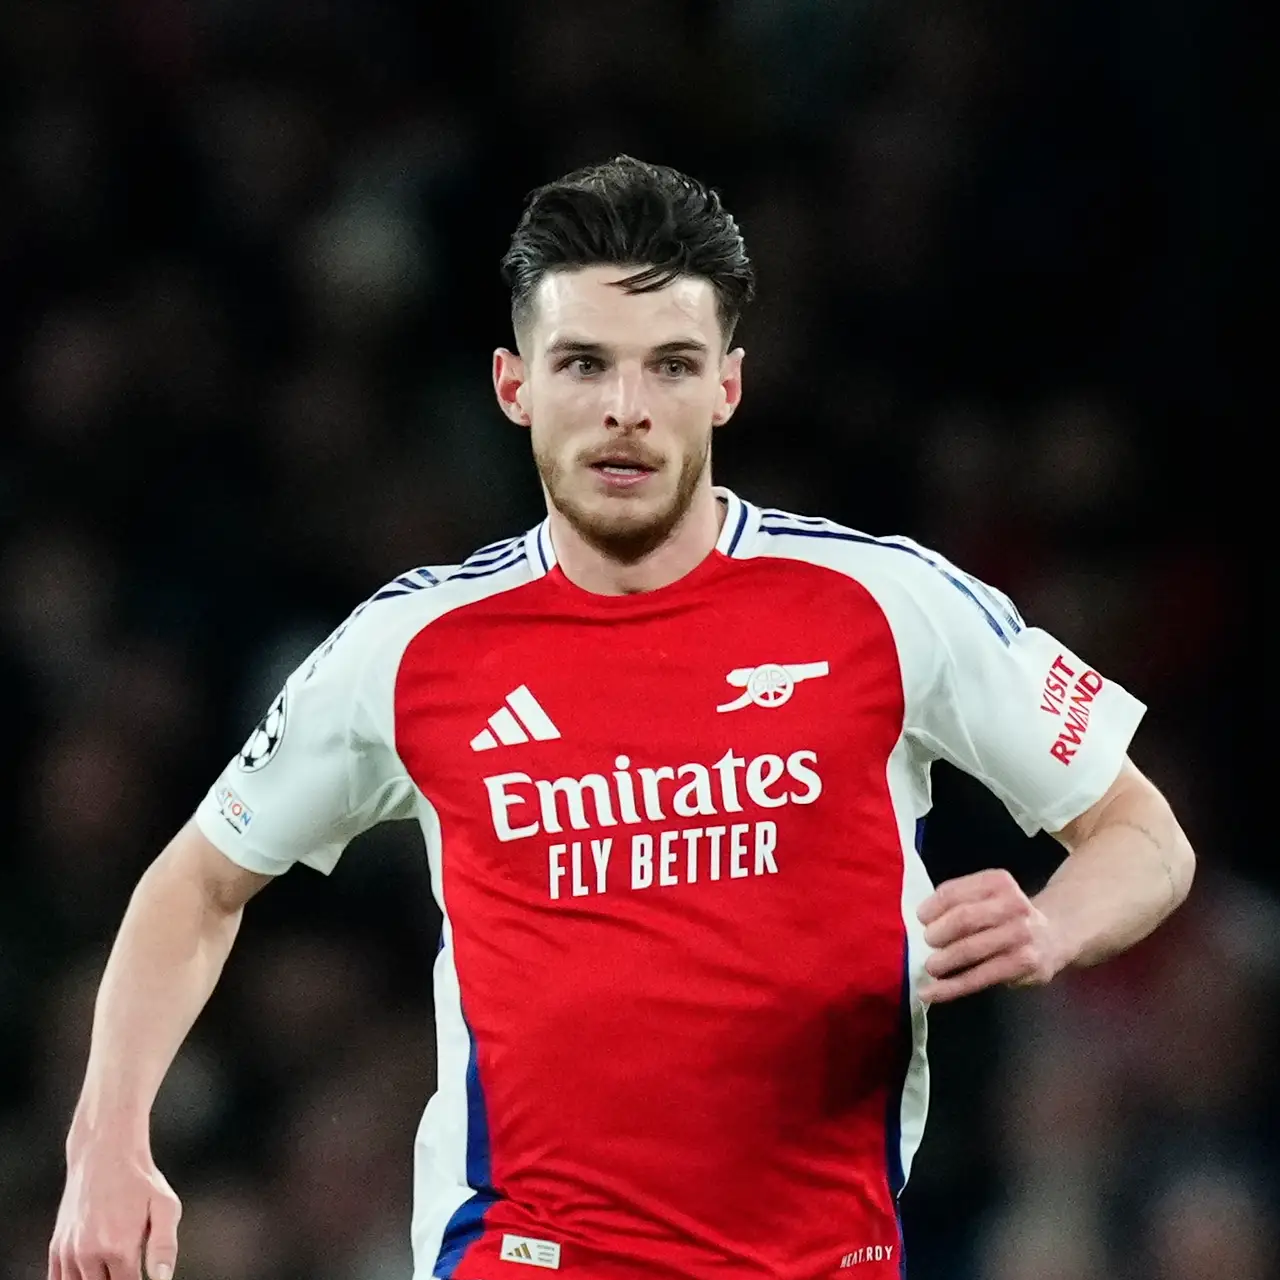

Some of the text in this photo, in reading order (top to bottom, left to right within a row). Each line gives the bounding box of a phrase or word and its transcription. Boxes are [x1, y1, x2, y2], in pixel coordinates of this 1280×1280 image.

[1040, 654, 1075, 716] VISIT
[483, 748, 821, 842] Emirates
[549, 821, 778, 899] FLY BETTER
